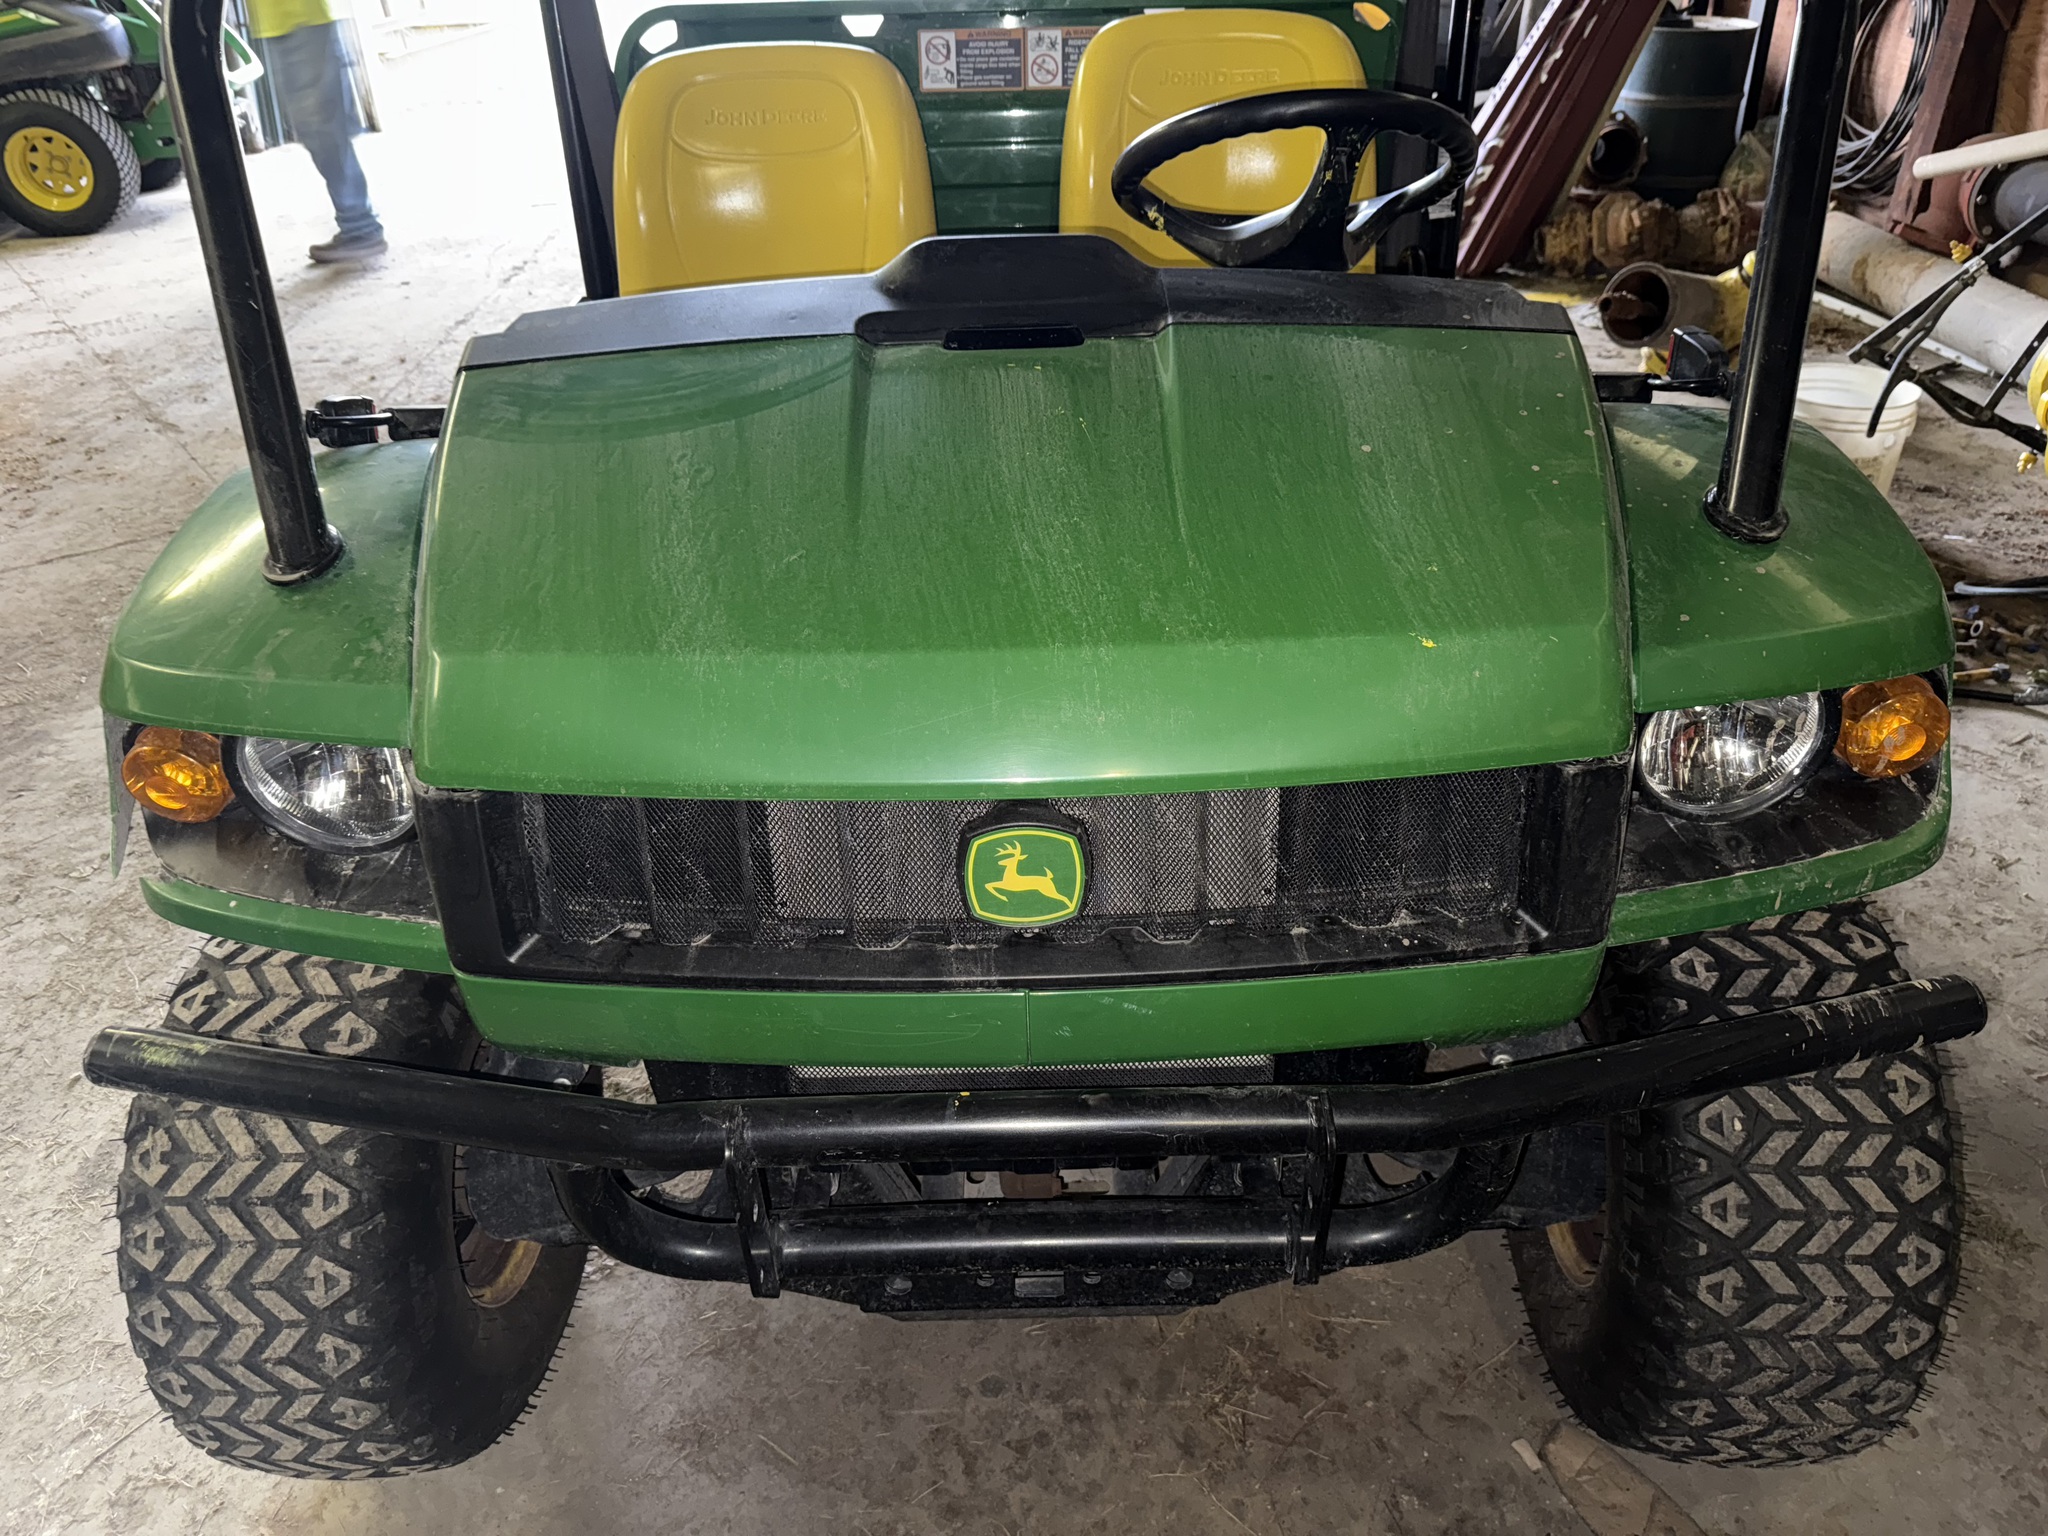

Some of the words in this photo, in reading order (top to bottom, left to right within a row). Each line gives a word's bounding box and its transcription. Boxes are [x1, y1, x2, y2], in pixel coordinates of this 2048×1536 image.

[975, 30, 1011, 38] WARNING
[1160, 68, 1213, 86] JOHN
[1214, 68, 1280, 85] DEERE
[704, 107, 760, 127] JOHN
[762, 107, 828, 125] DEERE
